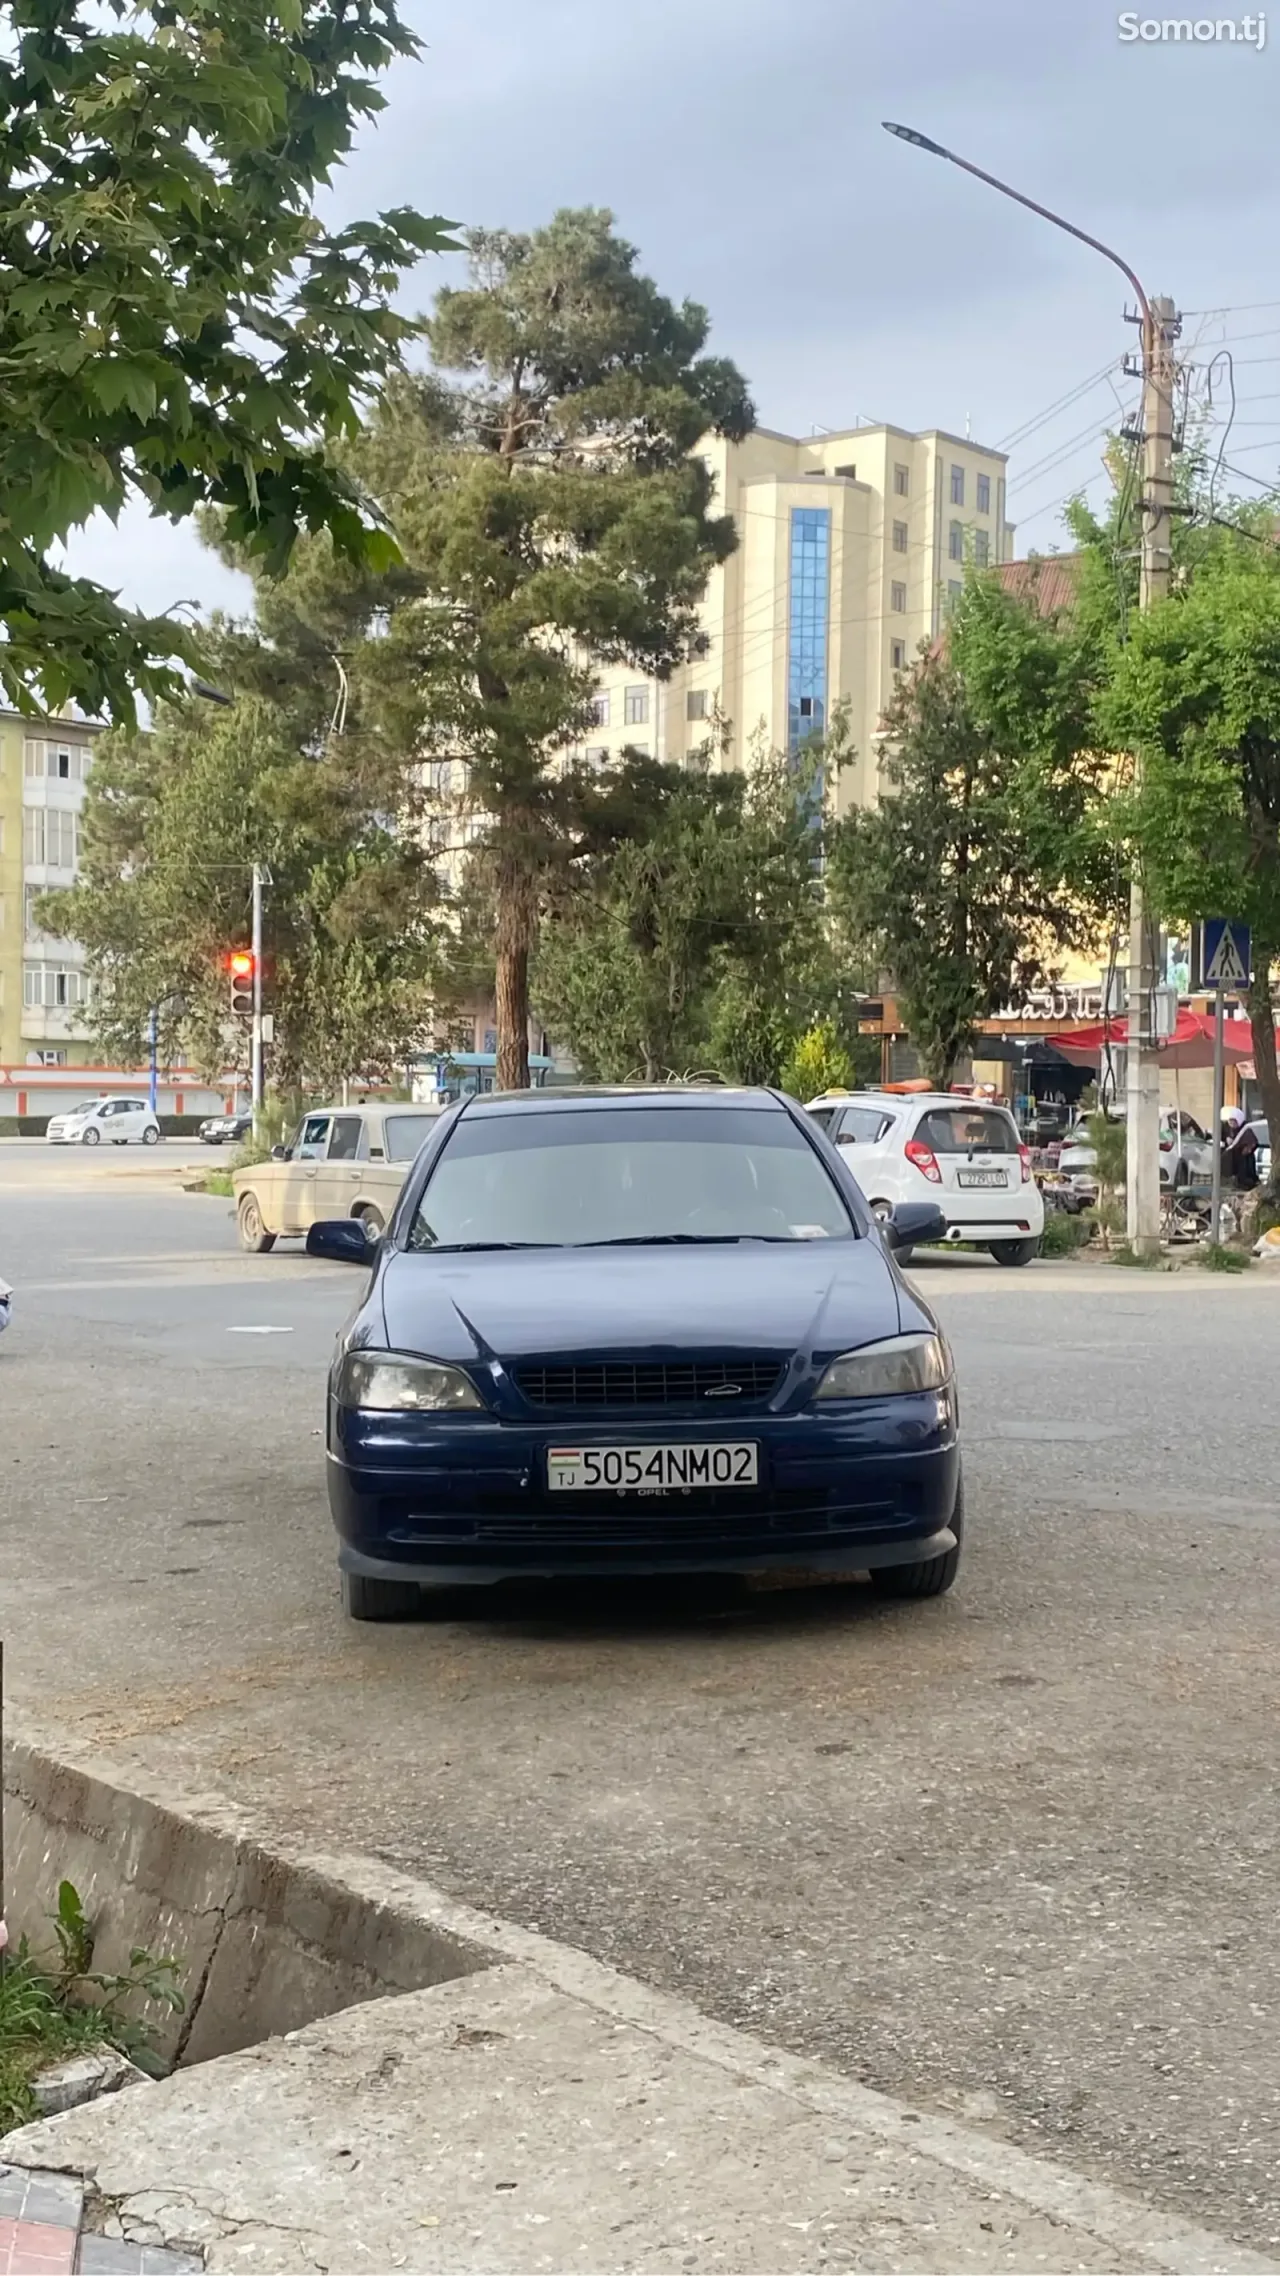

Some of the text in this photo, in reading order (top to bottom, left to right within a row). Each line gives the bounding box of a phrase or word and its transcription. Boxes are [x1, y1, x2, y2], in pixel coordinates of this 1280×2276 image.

[557, 1447, 753, 1487] TJ 5054NM02
[637, 1488, 670, 1497] OPEL
